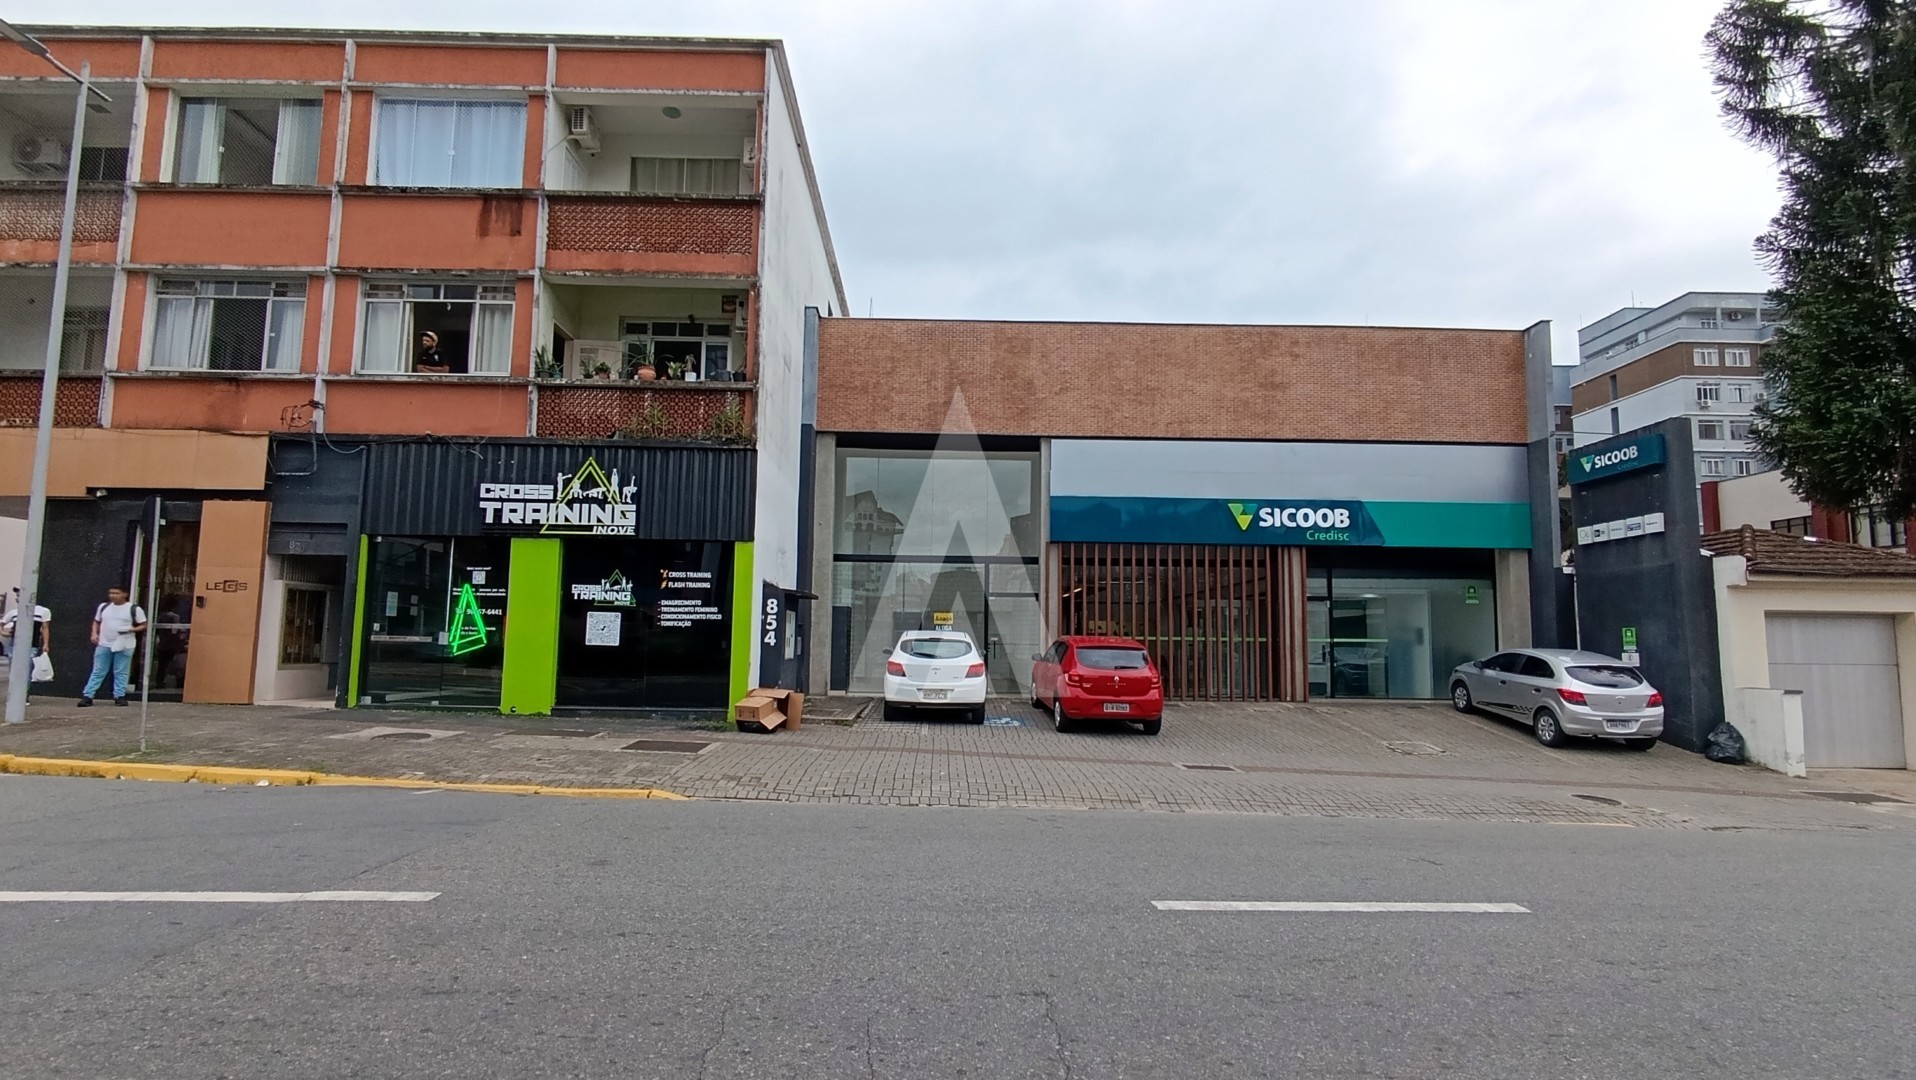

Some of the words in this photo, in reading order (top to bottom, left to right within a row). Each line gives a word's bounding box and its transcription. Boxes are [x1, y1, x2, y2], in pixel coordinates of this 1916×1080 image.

[1594, 445, 1639, 469] SICOOB
[480, 483, 554, 499] CROSS
[479, 501, 636, 525] TRAINING
[1258, 507, 1350, 528] SICOOB
[592, 526, 636, 535] INOVE
[1306, 530, 1350, 541] Credisc
[206, 580, 247, 593] LEGS
[571, 590, 632, 601] TRAINING
[660, 620, 692, 628] TONIFICAÇÃO
[764, 598, 778, 647] 854
